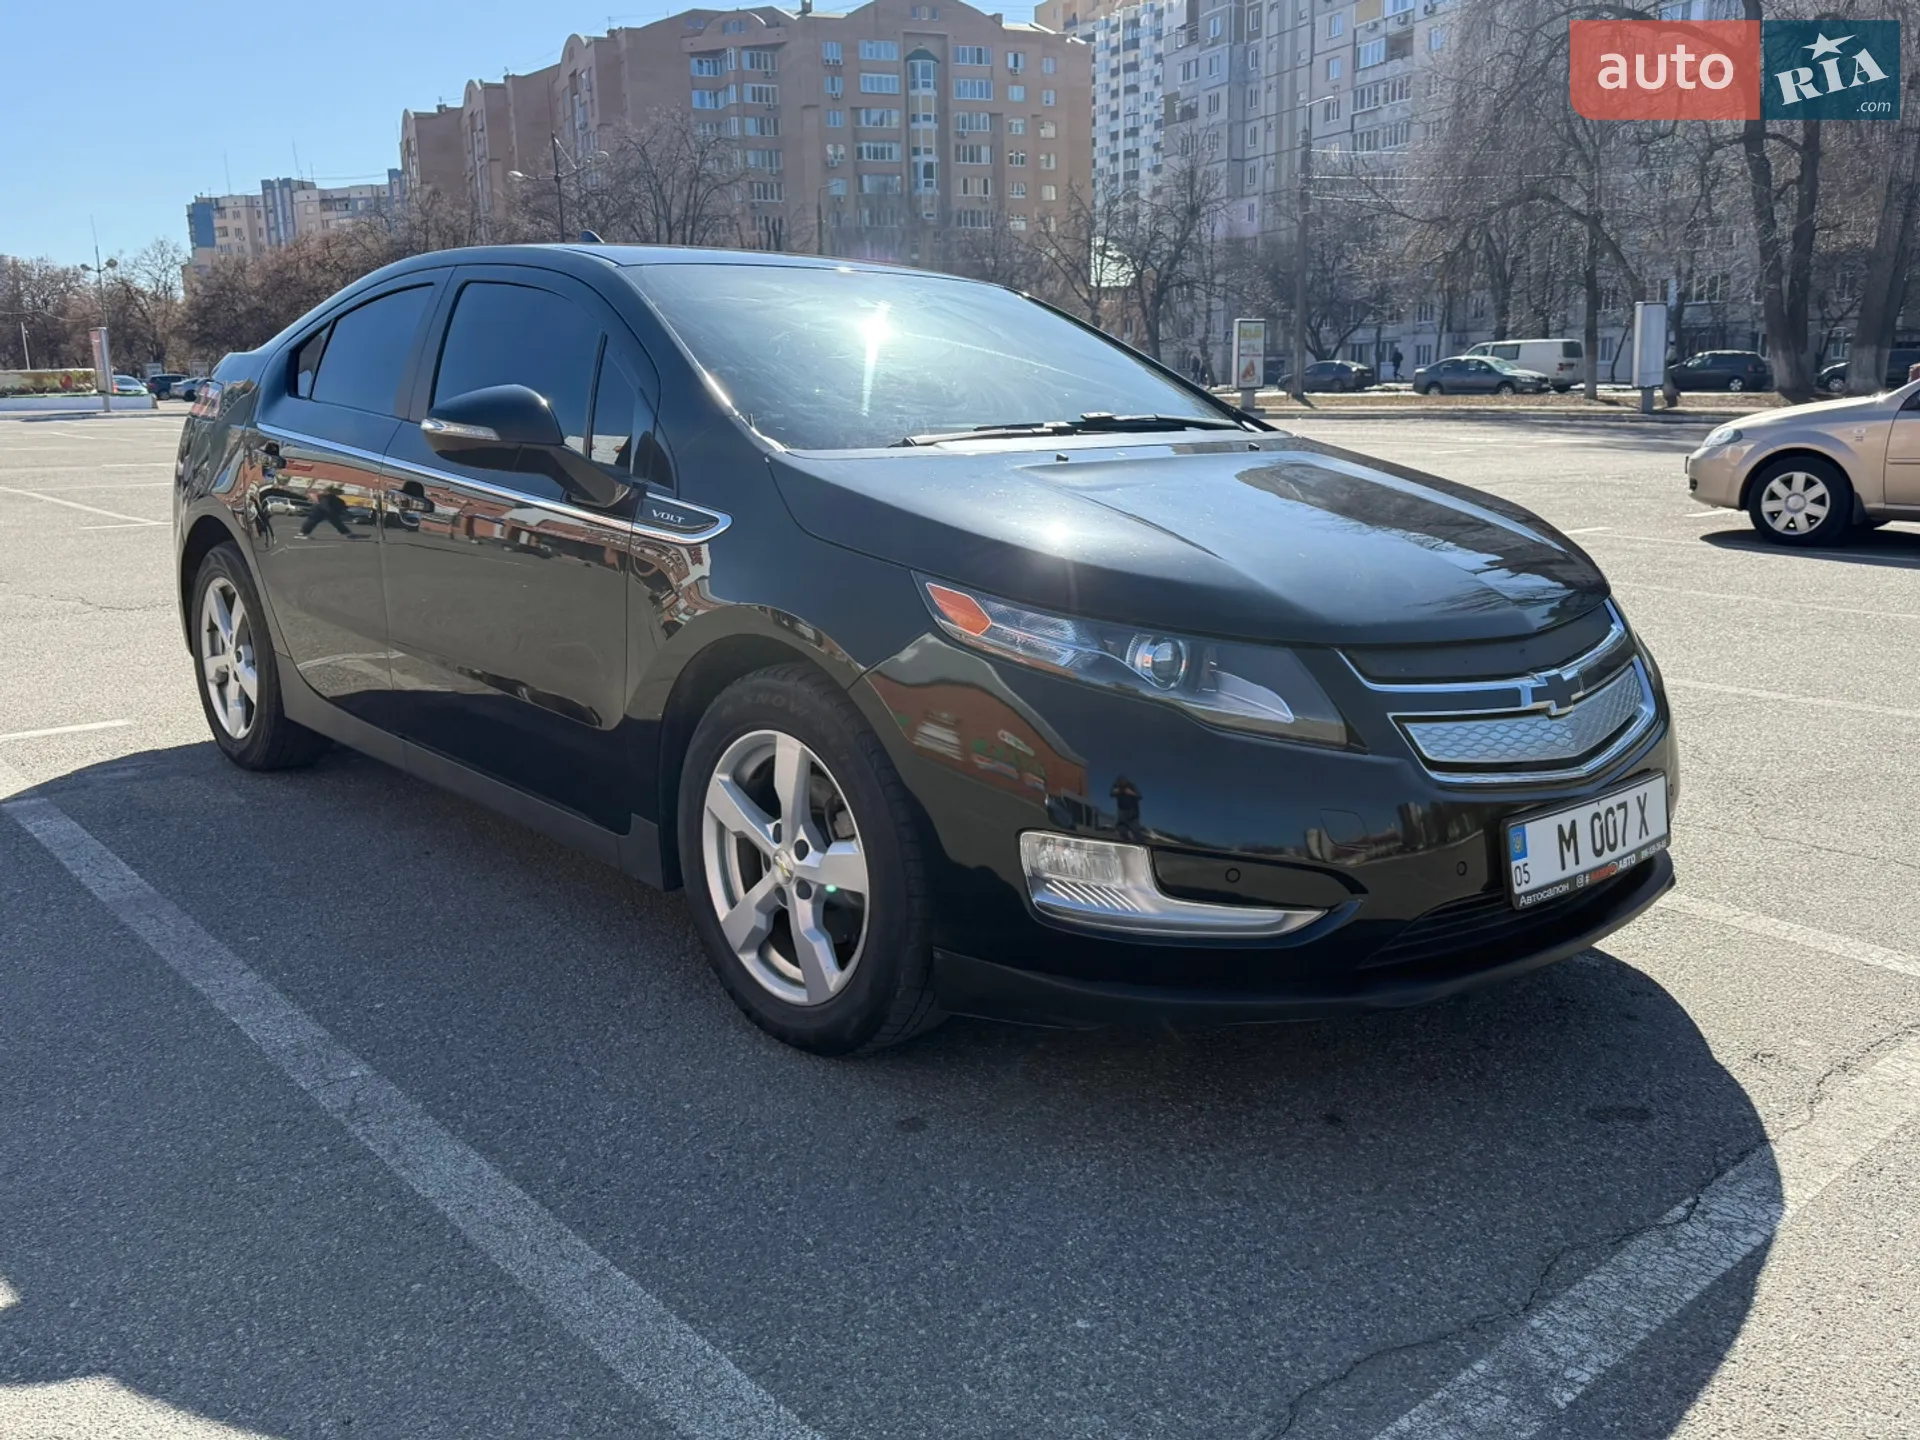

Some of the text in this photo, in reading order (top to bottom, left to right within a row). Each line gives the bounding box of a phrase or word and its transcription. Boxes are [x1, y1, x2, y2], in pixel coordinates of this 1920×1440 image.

[652, 509, 685, 523] VOLT
[1557, 792, 1650, 871] M 007 X
[1514, 862, 1531, 887] 05
